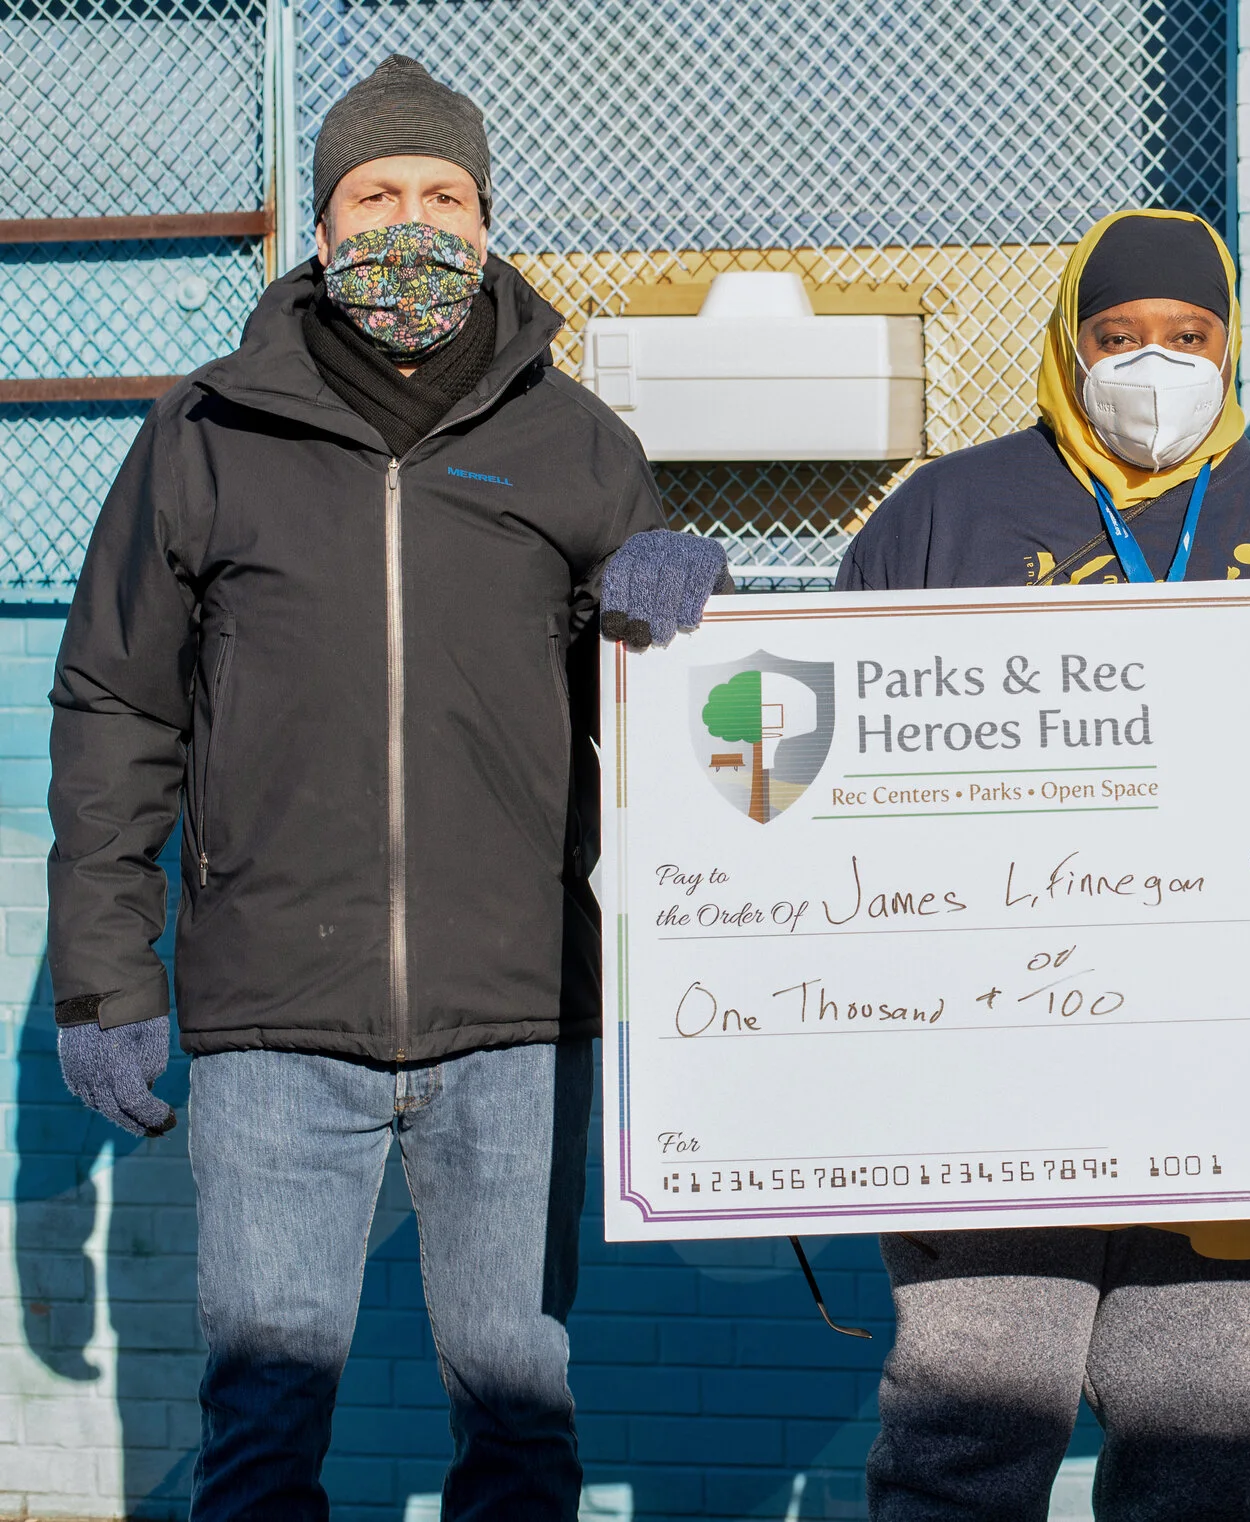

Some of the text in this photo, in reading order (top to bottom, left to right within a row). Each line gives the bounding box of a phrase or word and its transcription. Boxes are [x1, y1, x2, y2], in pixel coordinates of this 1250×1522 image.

[447, 466, 513, 487] MERRELL
[857, 655, 1146, 699] Parks & Rec
[858, 704, 1154, 753] Heroes Fund
[832, 776, 1159, 806] Rec Centers Parks Open Space
[656, 864, 730, 896] Pay to
[822, 856, 967, 925] James
[656, 901, 809, 932] the Order Of
[675, 981, 762, 1038] One
[772, 979, 945, 1029] Thousand
[657, 1131, 702, 1155] For
[1149, 1154, 1223, 1177] 1001
